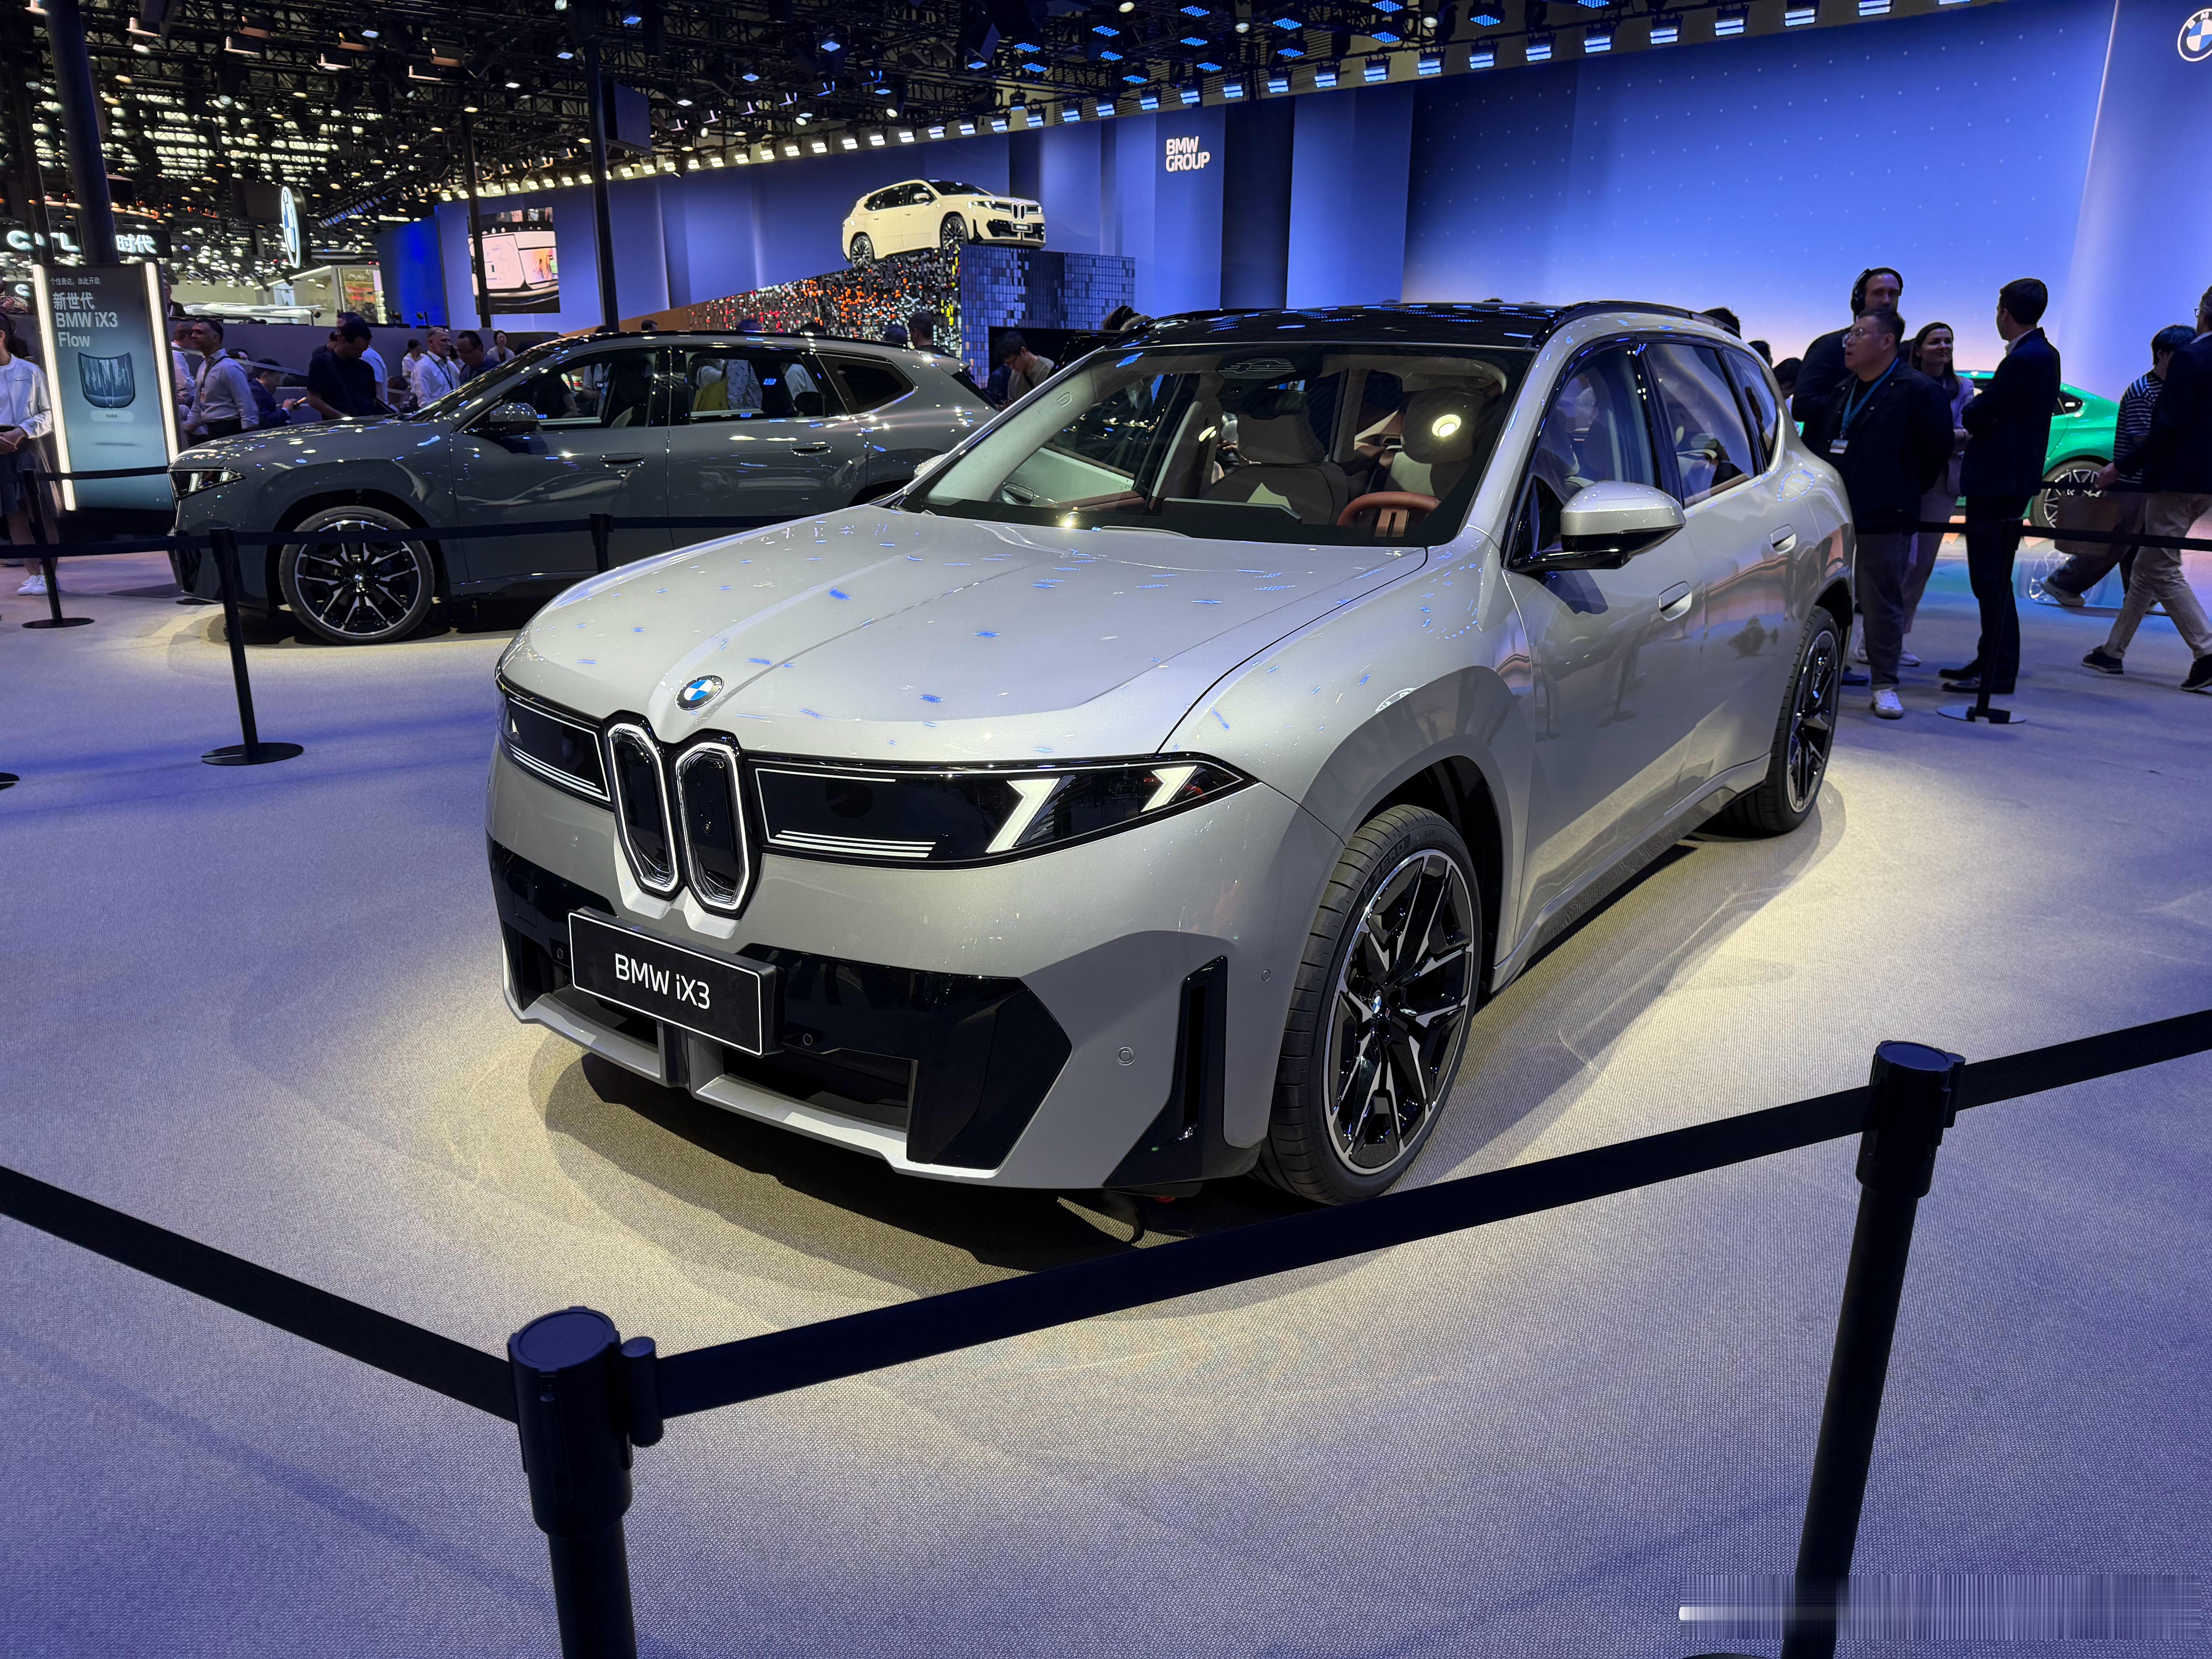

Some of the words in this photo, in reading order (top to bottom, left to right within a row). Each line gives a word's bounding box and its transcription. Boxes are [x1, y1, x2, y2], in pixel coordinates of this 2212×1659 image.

[2187, 12, 2212, 29] BM
[1166, 136, 1199, 155] BMW
[1166, 151, 1211, 172] GROUP
[52, 292, 95, 310] 新世代
[55, 312, 91, 328] BMW
[94, 312, 118, 328] iX3
[58, 331, 90, 347] Flow
[1373, 840, 1405, 883] ZERO
[615, 953, 669, 995] BMW
[676, 974, 710, 1009] iX3
